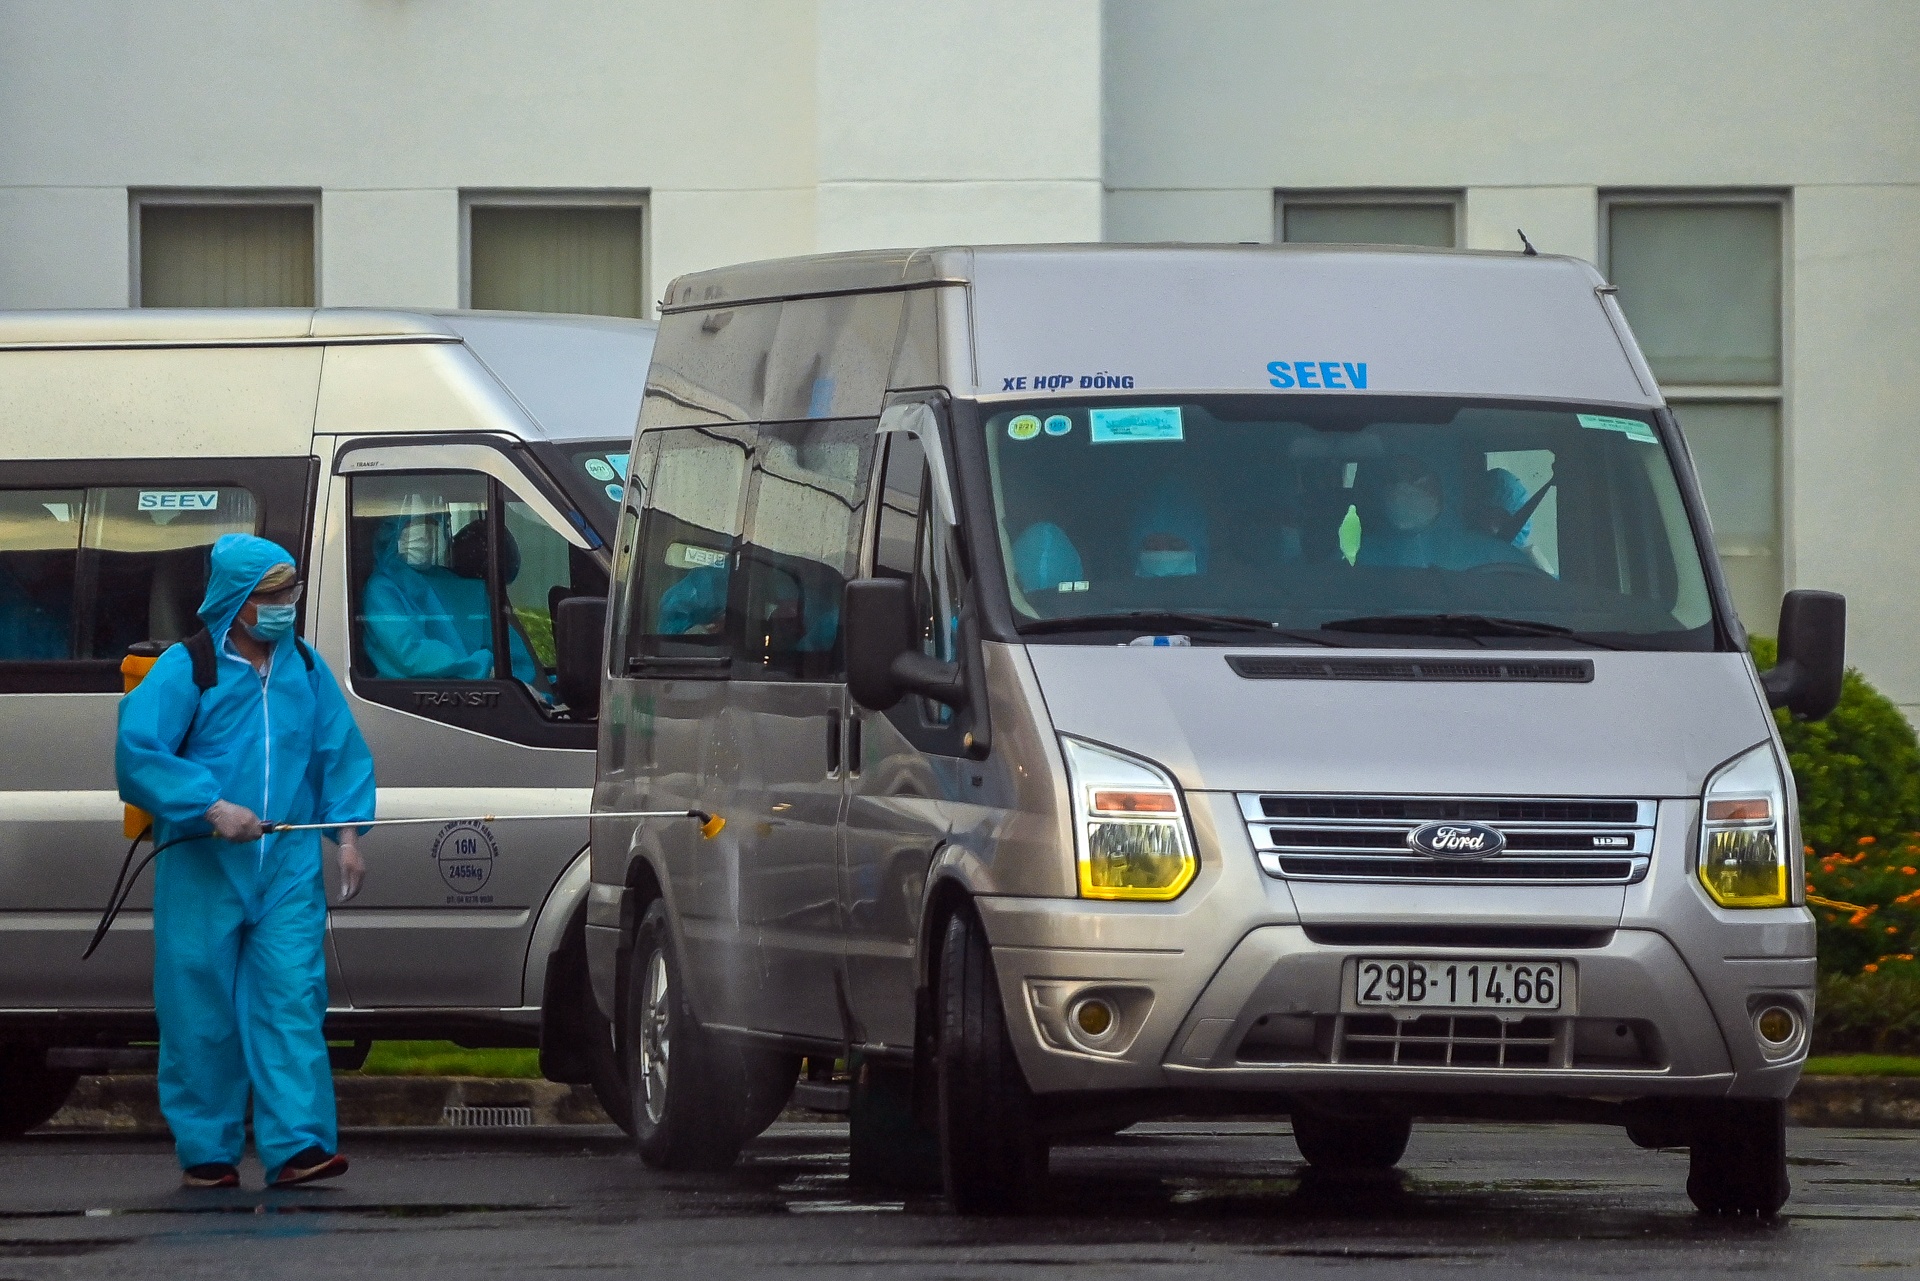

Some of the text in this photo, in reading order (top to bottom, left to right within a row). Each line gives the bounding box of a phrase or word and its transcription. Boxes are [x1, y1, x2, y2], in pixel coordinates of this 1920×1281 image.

[1002, 370, 1135, 392] XE HỢP ĐỒNG
[1266, 361, 1367, 390] SEEV
[141, 494, 216, 507] SEEV
[413, 691, 500, 705] TRANSIT
[455, 838, 477, 855] 16N
[1432, 826, 1484, 850] Ford
[449, 865, 483, 881] 2455kg
[1363, 963, 1555, 1004] 29B-114.66
